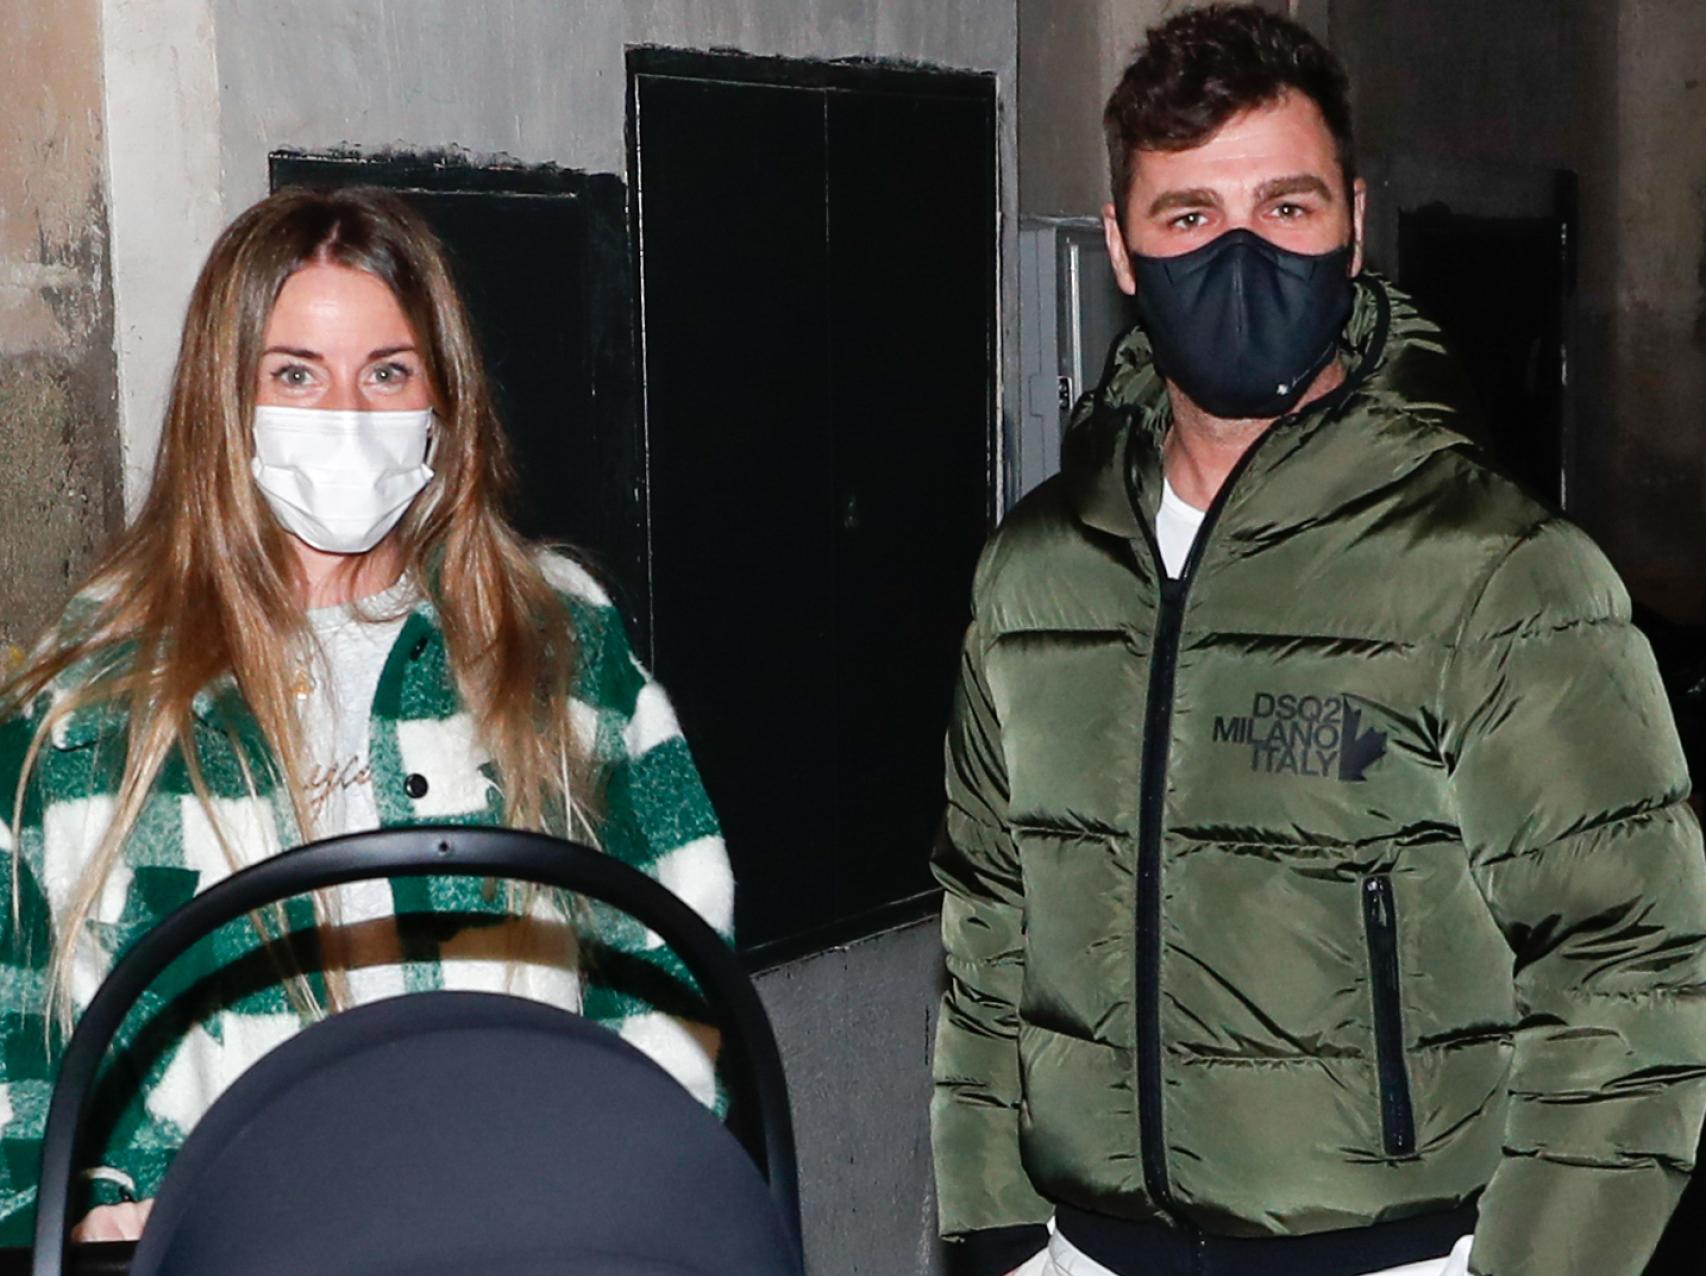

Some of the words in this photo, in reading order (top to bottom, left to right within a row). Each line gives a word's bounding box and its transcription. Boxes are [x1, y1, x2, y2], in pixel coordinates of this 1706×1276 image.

[1252, 692, 1342, 724] DSQ2
[1212, 716, 1339, 750] MILANO
[1251, 743, 1338, 777] ITALY
